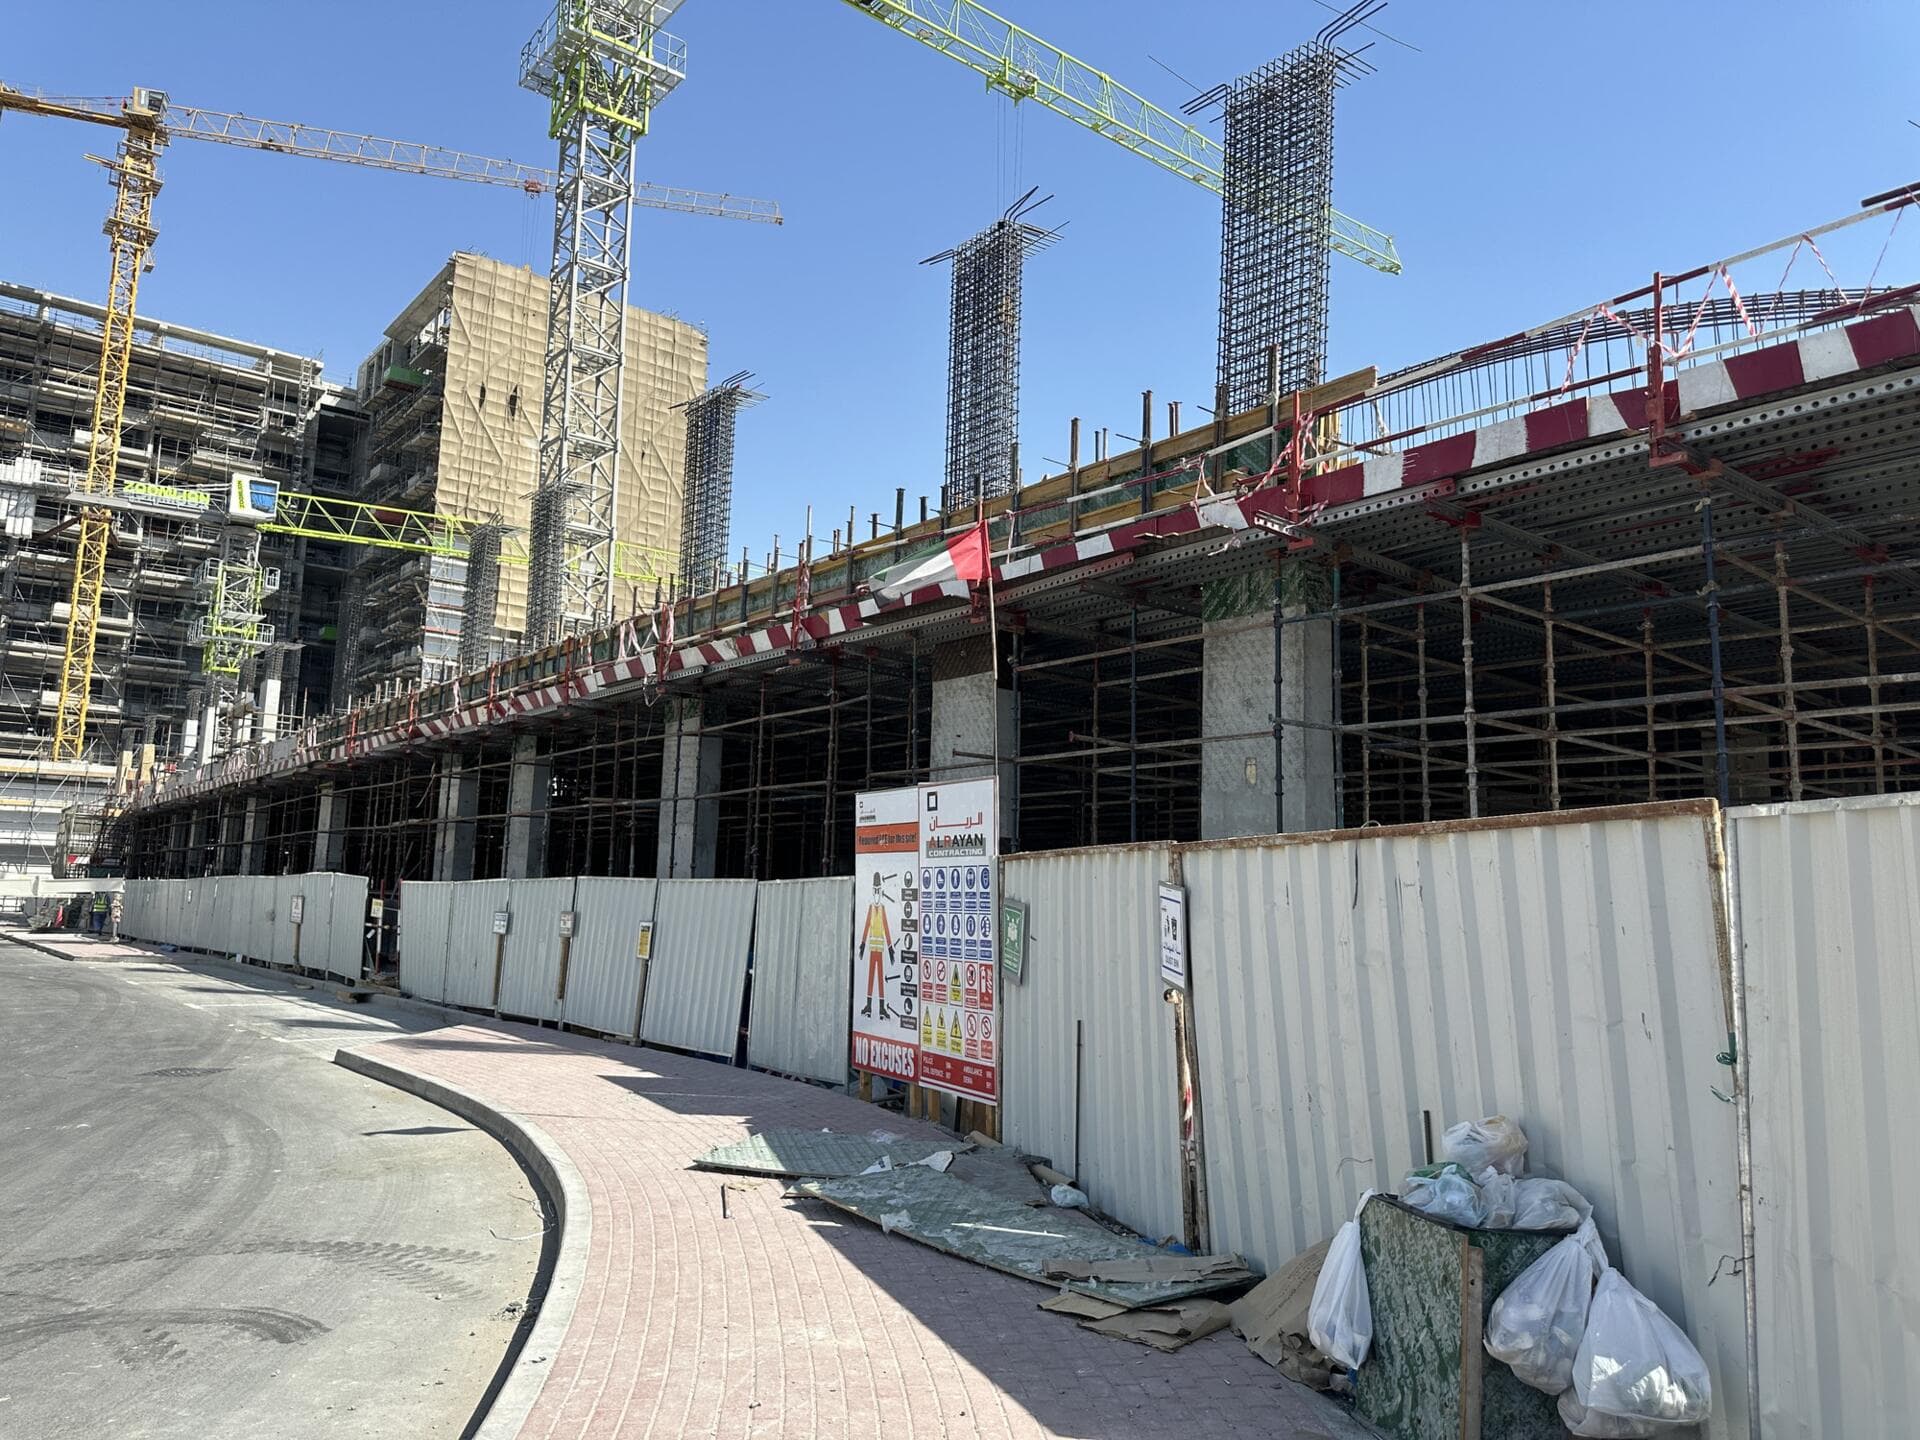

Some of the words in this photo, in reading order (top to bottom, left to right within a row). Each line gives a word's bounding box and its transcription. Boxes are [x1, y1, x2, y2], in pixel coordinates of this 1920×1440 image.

[122, 480, 210, 505] ZOOMLION
[928, 848, 983, 857] CONTRACTING
[855, 1036, 868, 1066] NO
[870, 1040, 915, 1078] EXCUSES
